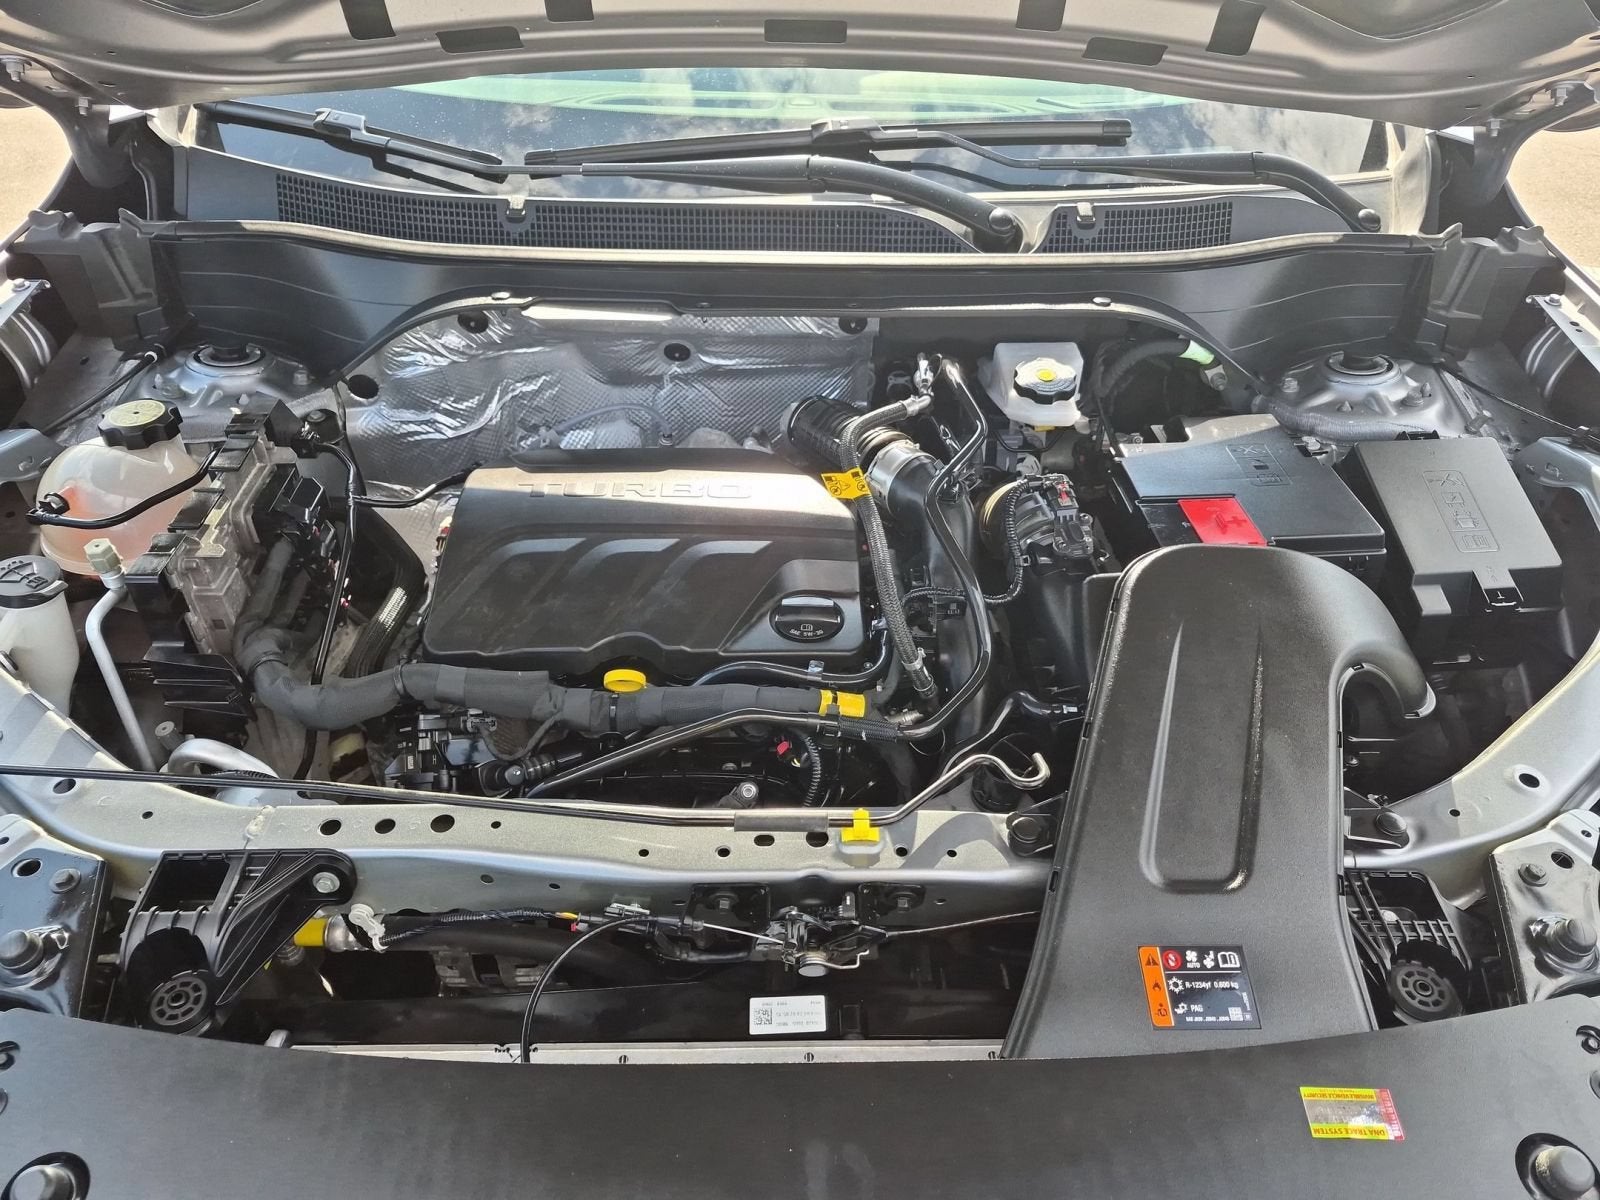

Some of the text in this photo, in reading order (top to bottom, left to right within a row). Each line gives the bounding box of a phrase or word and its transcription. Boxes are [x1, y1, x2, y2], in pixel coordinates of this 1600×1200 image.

[518, 482, 751, 499] TURBO
[1185, 981, 1211, 990] R-1234yf
[1230, 981, 1239, 990] kg
[1190, 1004, 1204, 1012] PAG
[1313, 1127, 1385, 1136] DNA TRACE SYSTEM
